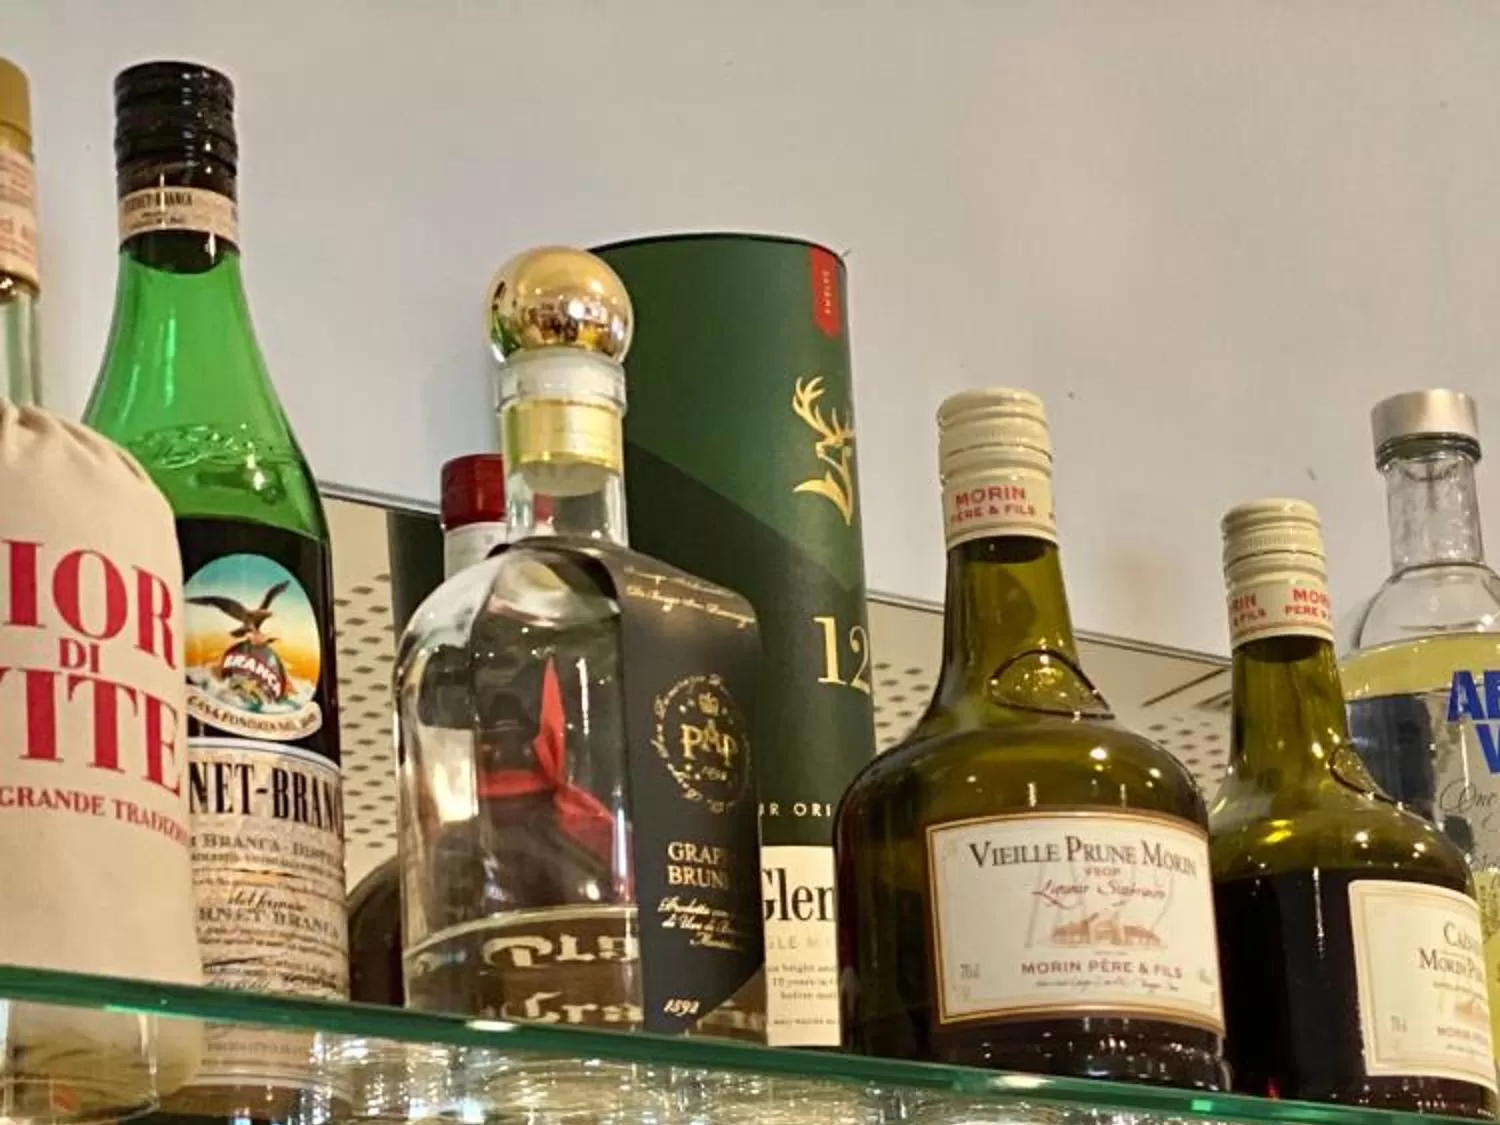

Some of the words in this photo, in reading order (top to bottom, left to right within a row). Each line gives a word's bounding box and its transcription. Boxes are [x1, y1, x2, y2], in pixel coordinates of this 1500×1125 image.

[955, 485, 1026, 507] MORIN
[58, 637, 100, 674] DI
[813, 616, 872, 696] 12
[0, 666, 182, 799] ITE
[0, 785, 106, 817] GRANDE
[968, 840, 1062, 868] VIEILLE
[1064, 834, 1139, 865] PRUNE
[1140, 839, 1199, 878] MORIN
[1021, 959, 1083, 976] MORIN
[1087, 956, 1134, 974] PÈRE
[1137, 961, 1149, 975] &
[1153, 963, 1183, 980] FILS
